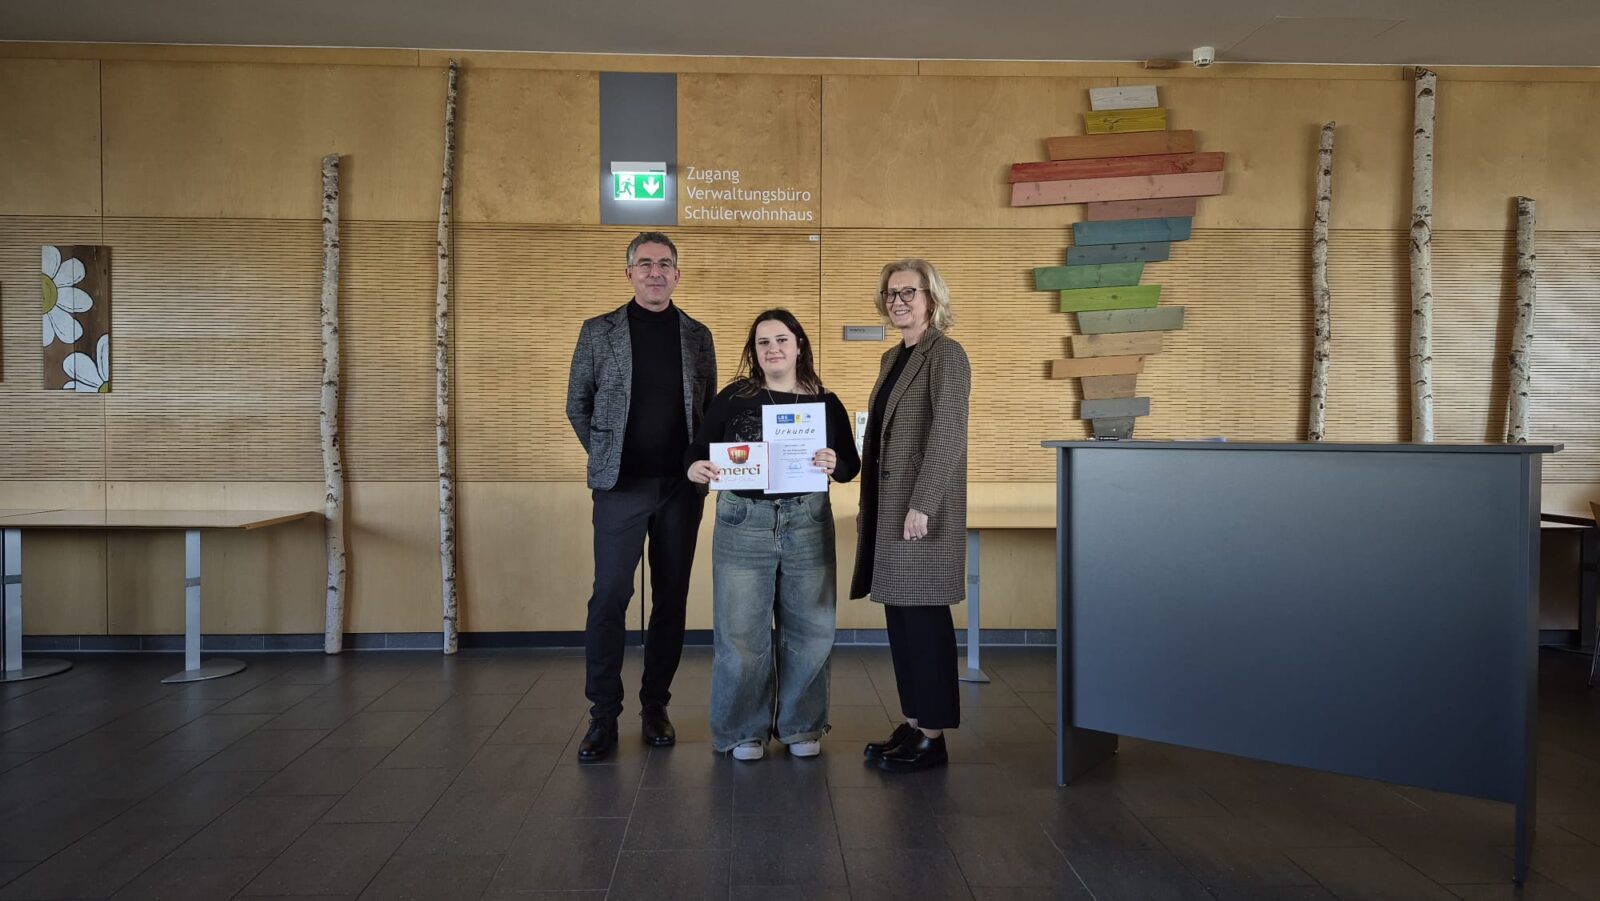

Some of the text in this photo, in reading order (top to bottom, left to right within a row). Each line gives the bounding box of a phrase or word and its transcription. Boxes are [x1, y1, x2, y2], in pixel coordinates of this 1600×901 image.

[686, 166, 740, 184] Zugang
[686, 187, 811, 203] Verwaltungsbüro
[684, 205, 813, 221] Schülerwohnhaus
[720, 464, 760, 475] merci
